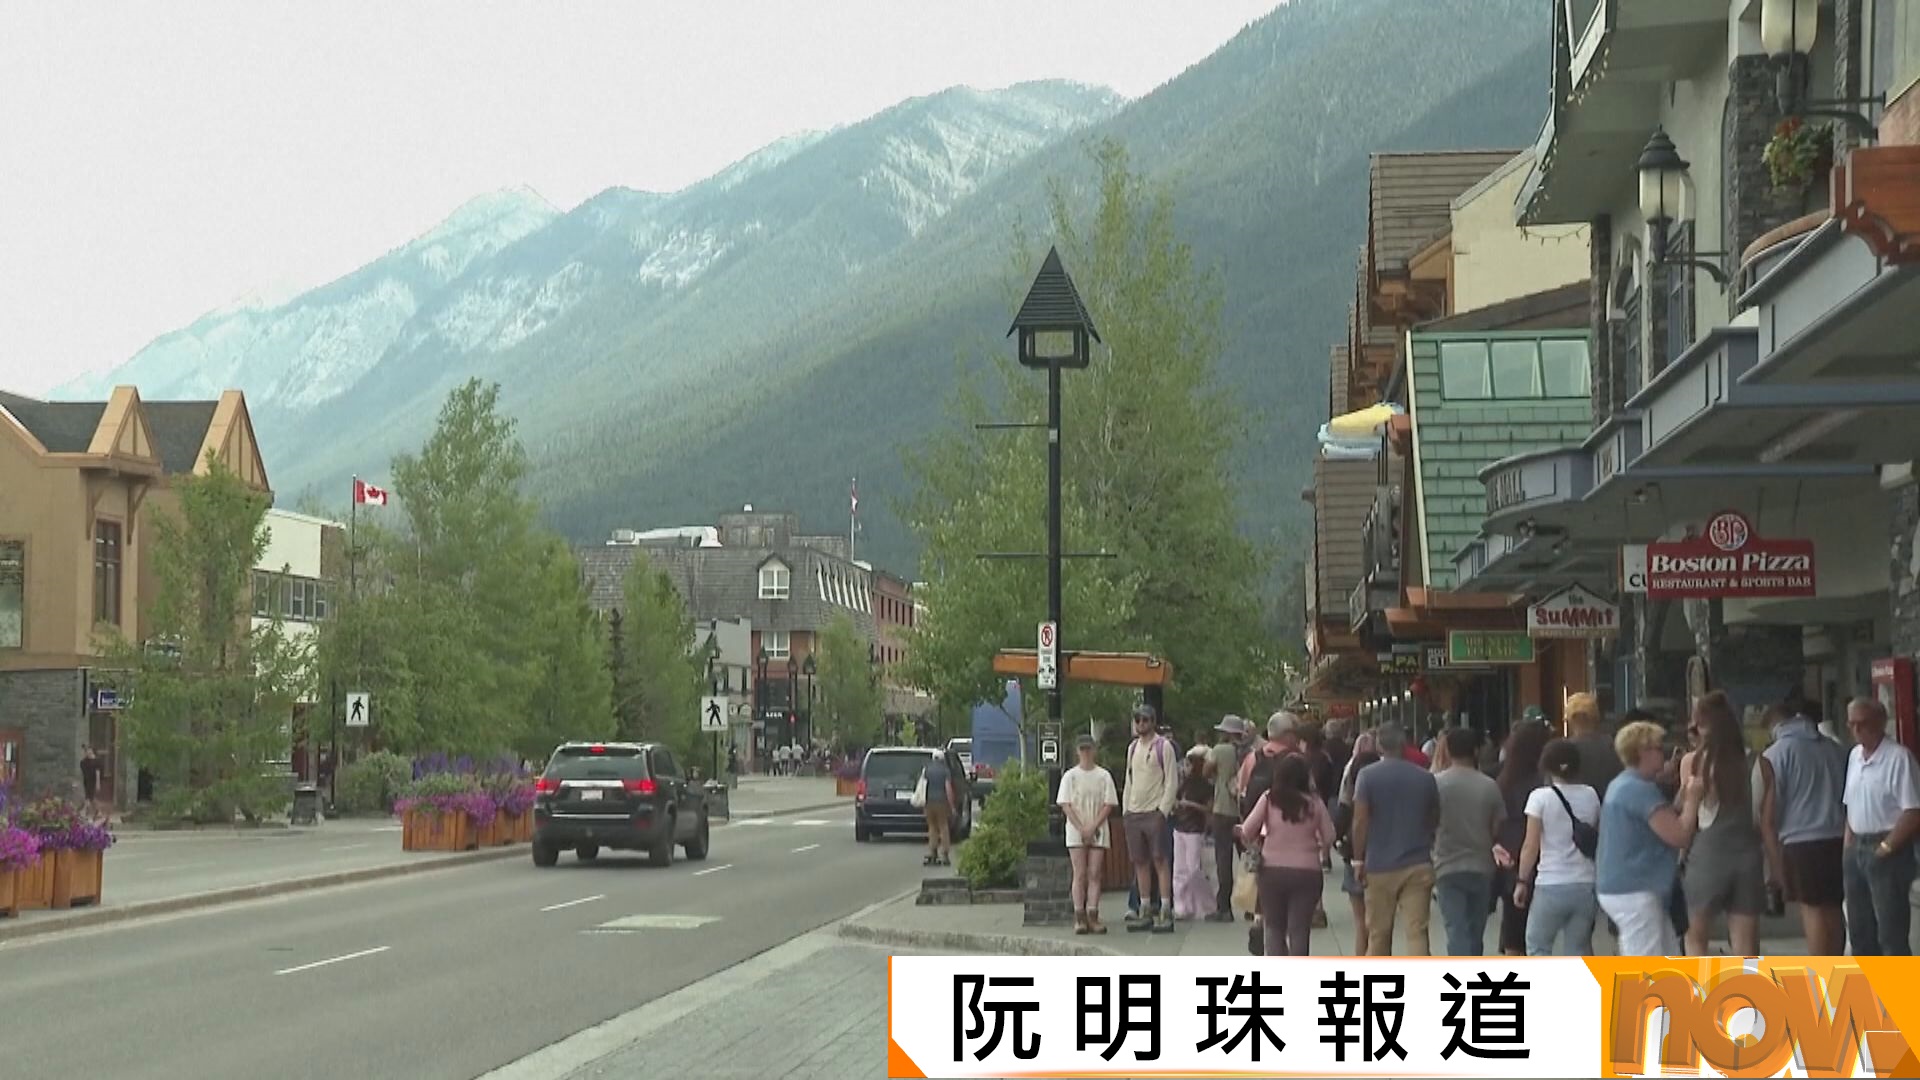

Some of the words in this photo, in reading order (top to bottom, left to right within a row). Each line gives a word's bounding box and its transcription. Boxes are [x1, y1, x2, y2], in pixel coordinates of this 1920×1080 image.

[1651, 554, 1737, 573] Boston
[1742, 552, 1811, 572] Pizza
[1652, 577, 1727, 588] RESTAURANT
[1740, 576, 1785, 588] SPORTS
[1787, 575, 1811, 587] BAR
